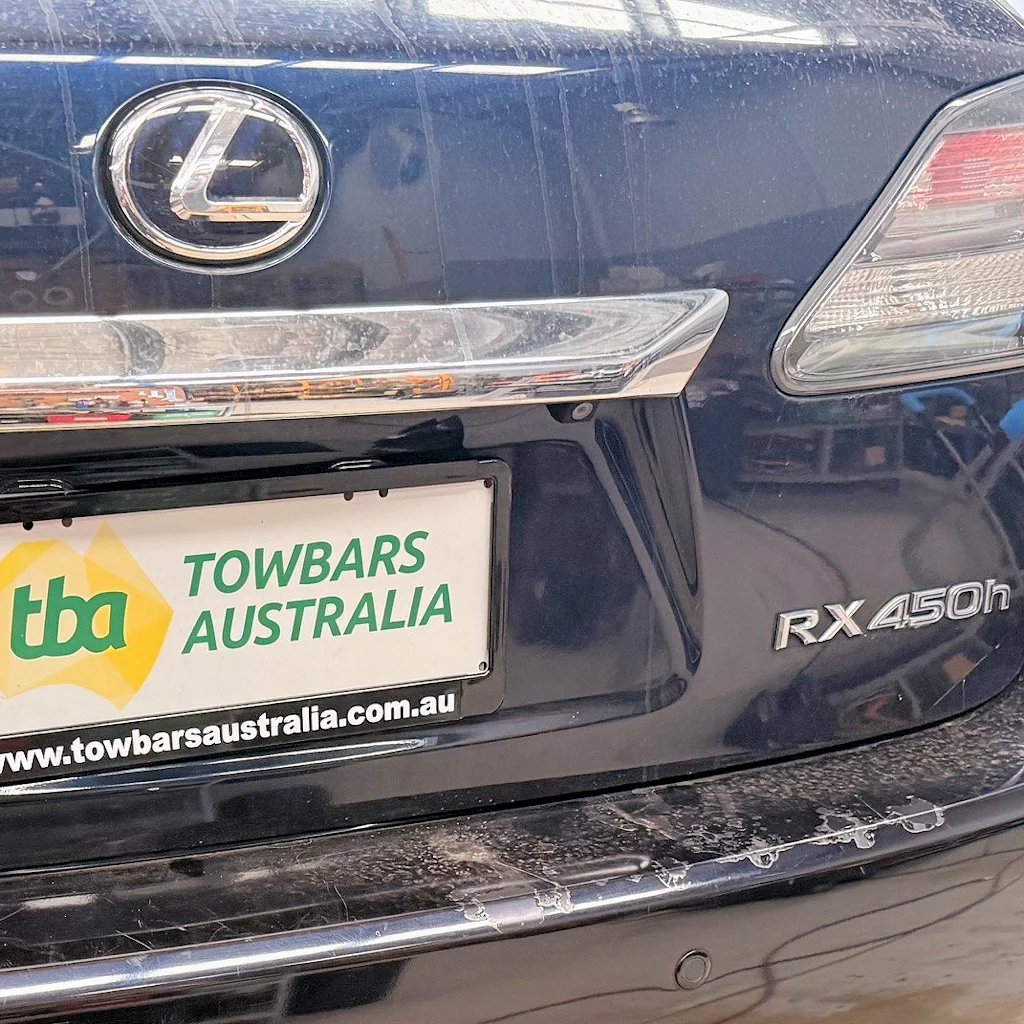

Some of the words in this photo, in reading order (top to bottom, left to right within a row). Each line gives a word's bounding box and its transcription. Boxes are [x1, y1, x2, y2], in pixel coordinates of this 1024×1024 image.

[183, 531, 429, 597] TOWBARS
[10, 576, 128, 660] tba
[182, 584, 453, 655] AUSTRALIA
[775, 598, 866, 650] RX
[866, 579, 1011, 631] 450h
